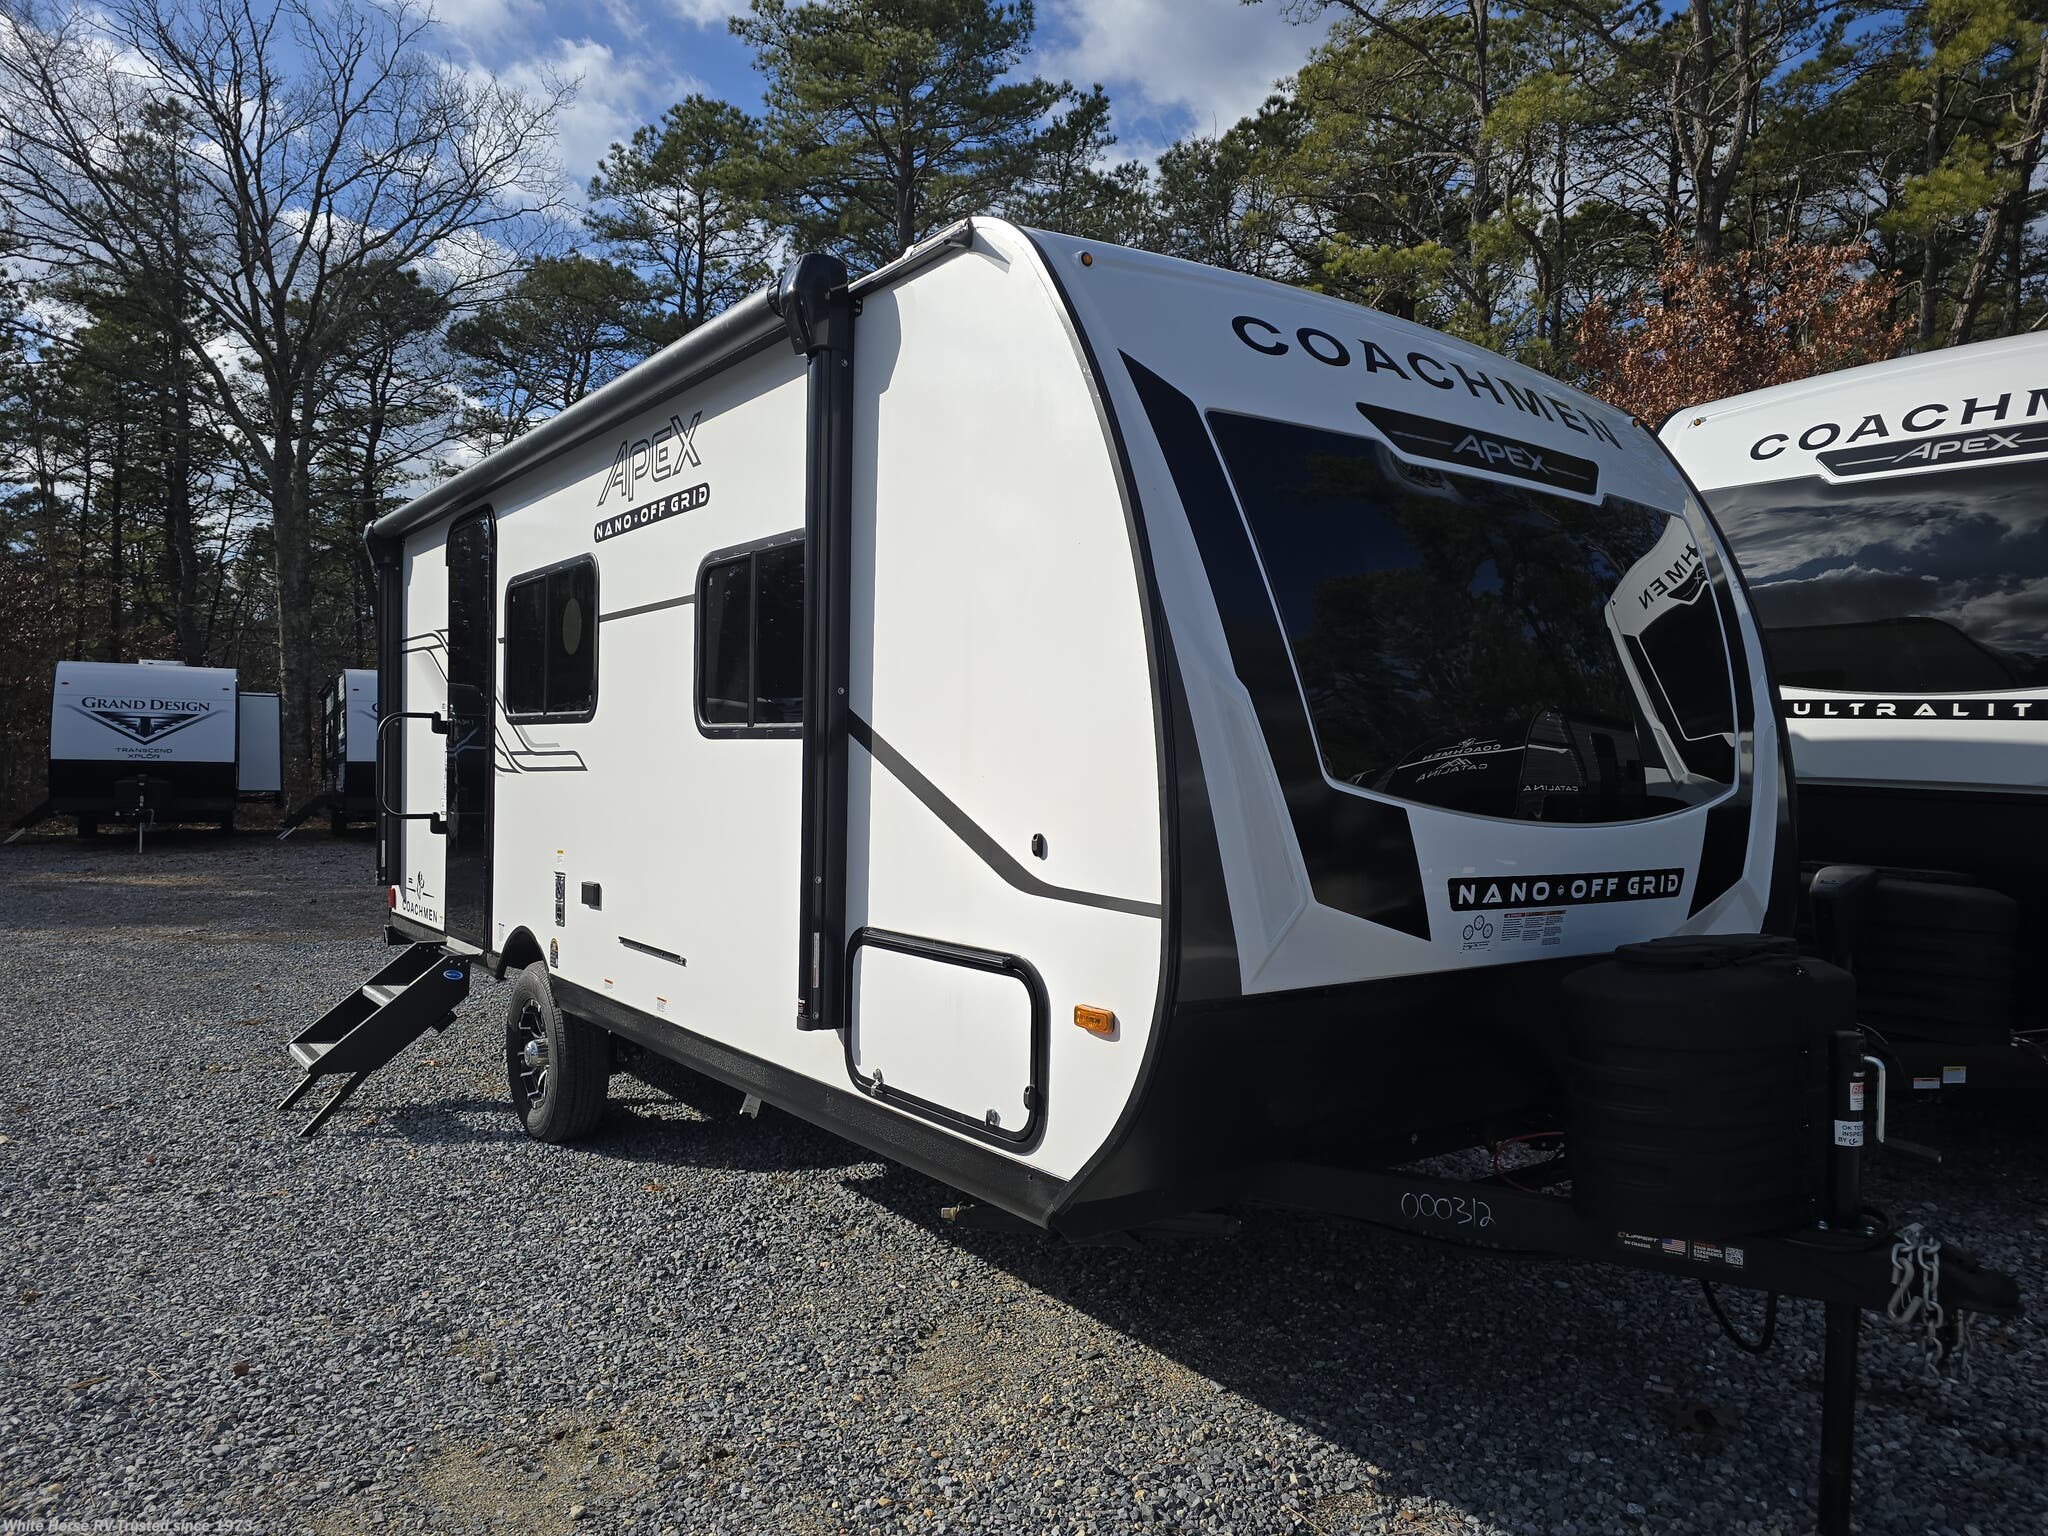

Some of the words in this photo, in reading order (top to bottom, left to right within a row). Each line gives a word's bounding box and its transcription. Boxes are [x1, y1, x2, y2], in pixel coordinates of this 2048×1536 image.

[1231, 315, 1624, 451] COACHMEN
[597, 410, 703, 507] APEX
[1452, 433, 1551, 475] APEX
[1891, 432, 2023, 463] APEX
[596, 514, 632, 540] NANO
[640, 501, 666, 523] OFF
[670, 486, 708, 513] GRID
[81, 696, 146, 710] GRAND
[150, 699, 211, 712] DESIGN
[1793, 702, 2033, 717] ULTRALIT
[1457, 881, 1550, 905] NANO
[1570, 877, 1619, 899] OFF
[1627, 874, 1680, 895] GRID
[402, 899, 438, 924] COACHMEN
[1400, 1192, 1497, 1228] 000312
[1625, 1233, 1659, 1243] LIPPERT
